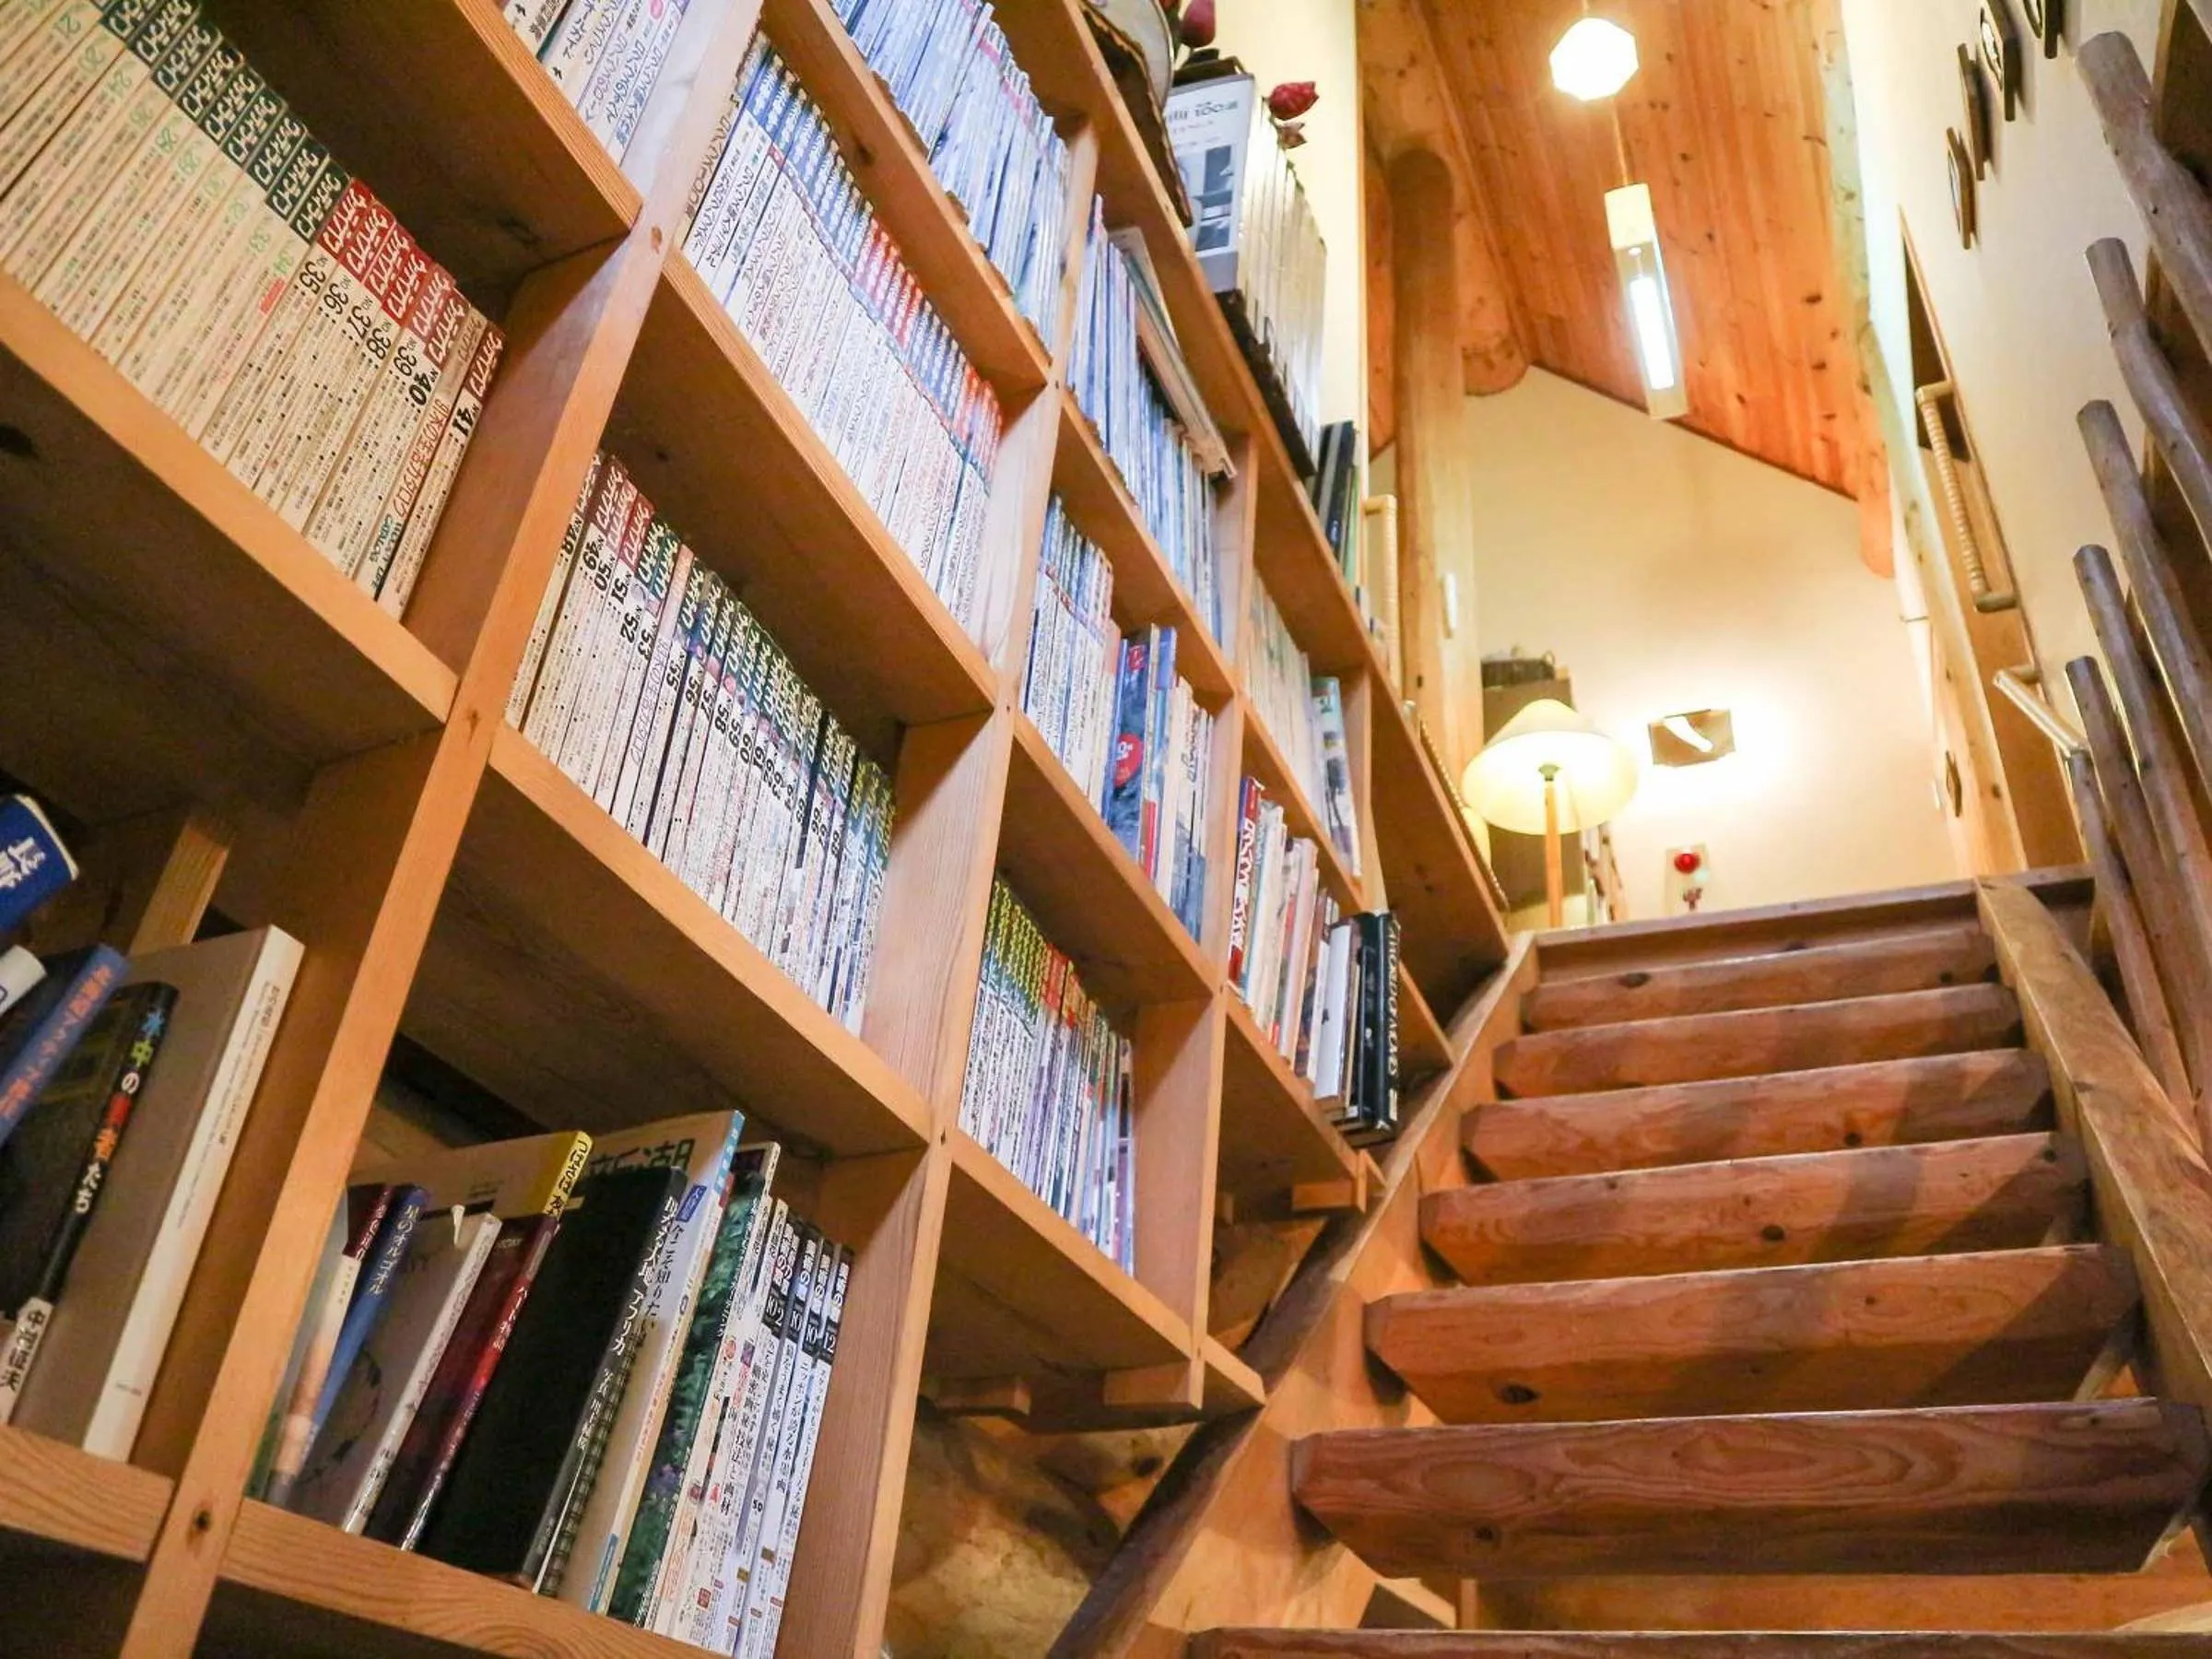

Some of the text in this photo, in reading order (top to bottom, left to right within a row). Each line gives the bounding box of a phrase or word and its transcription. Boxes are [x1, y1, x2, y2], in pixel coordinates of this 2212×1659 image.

[295, 260, 328, 294] 35
[320, 282, 351, 314] 36
[342, 304, 374, 338] 37
[362, 327, 394, 360] 38
[390, 346, 419, 376] 39
[405, 371, 436, 406] 40
[450, 405, 477, 436] 41
[580, 540, 602, 571] 49
[591, 560, 612, 591] 50
[609, 578, 629, 602] 51
[618, 612, 640, 642] 52
[634, 629, 654, 659] 53
[712, 704, 730, 732] 58
[726, 718, 742, 746] 59
[738, 733, 753, 763] 60
[609, 1288, 645, 1356] アフリカ
